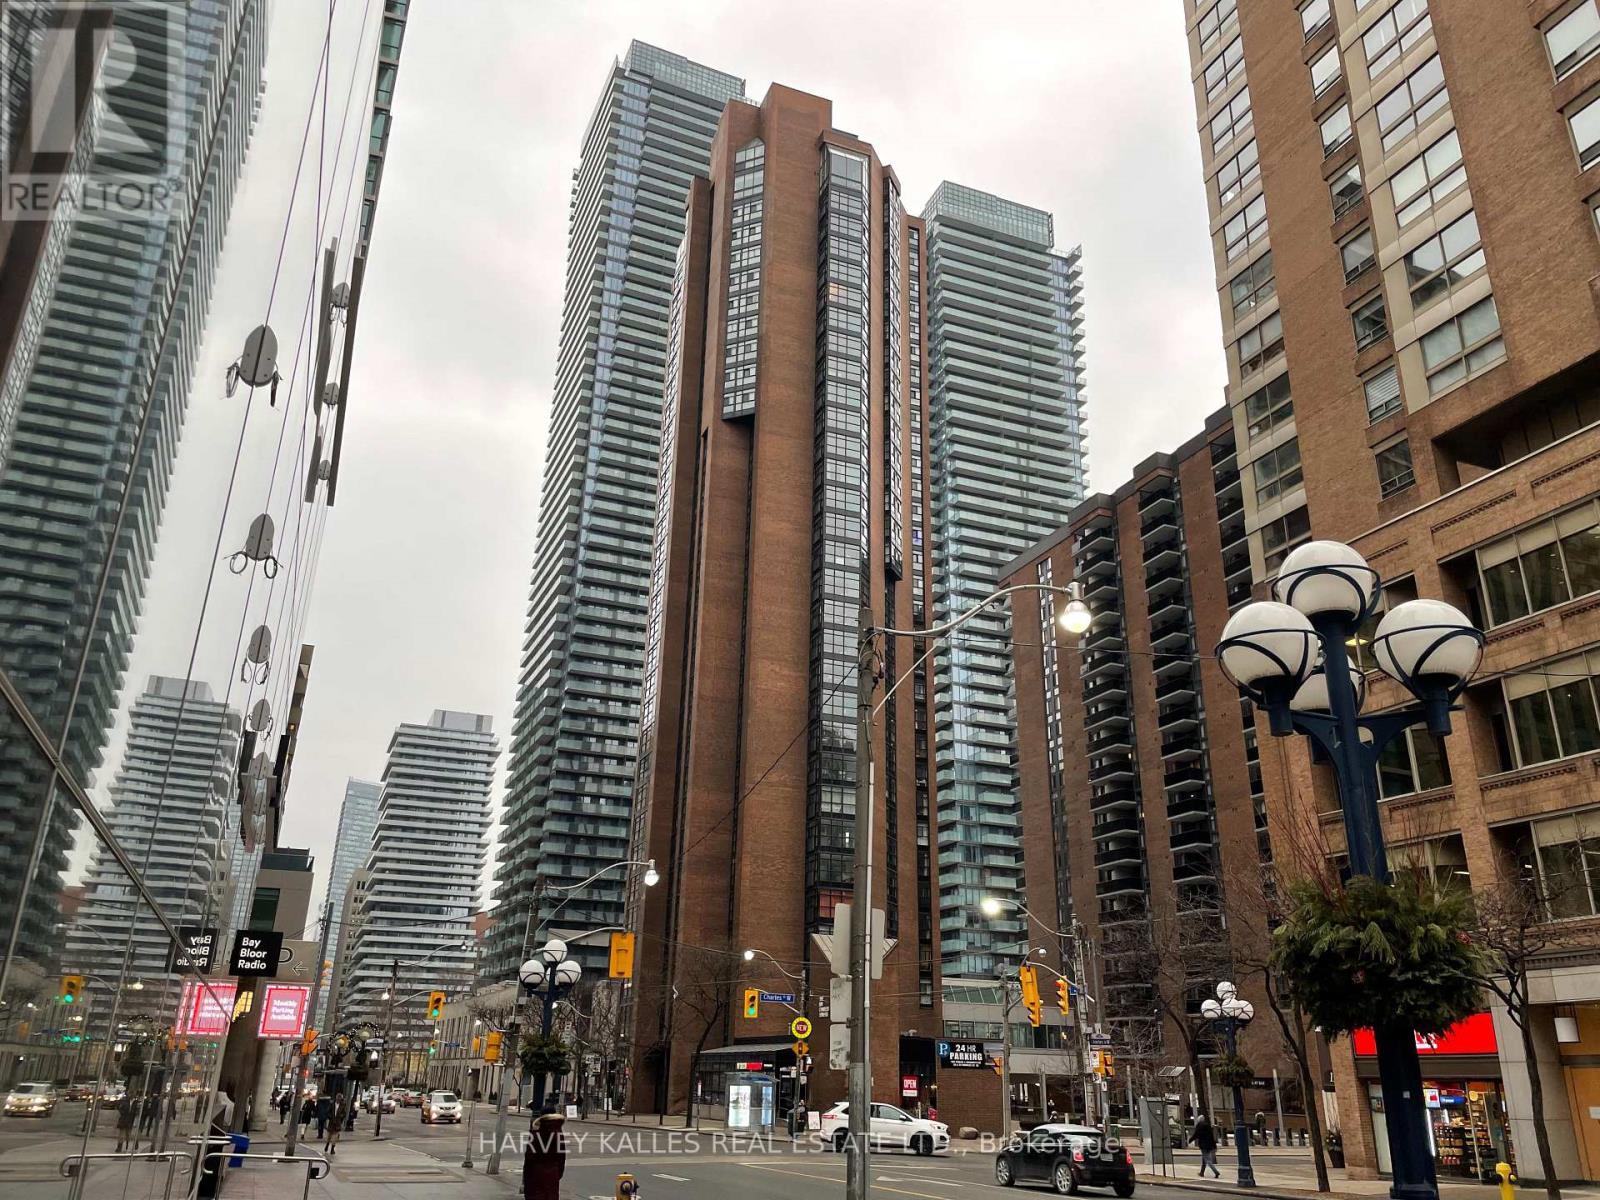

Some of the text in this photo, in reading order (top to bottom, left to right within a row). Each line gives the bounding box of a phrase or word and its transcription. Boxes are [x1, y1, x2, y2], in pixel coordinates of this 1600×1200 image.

[242, 937, 261, 948] Bay
[240, 948, 267, 958] Bloor
[238, 959, 267, 969] Radio
[955, 1044, 966, 1052] 24
[950, 1052, 983, 1061] PARKING
[903, 1079, 916, 1089] OPEN
